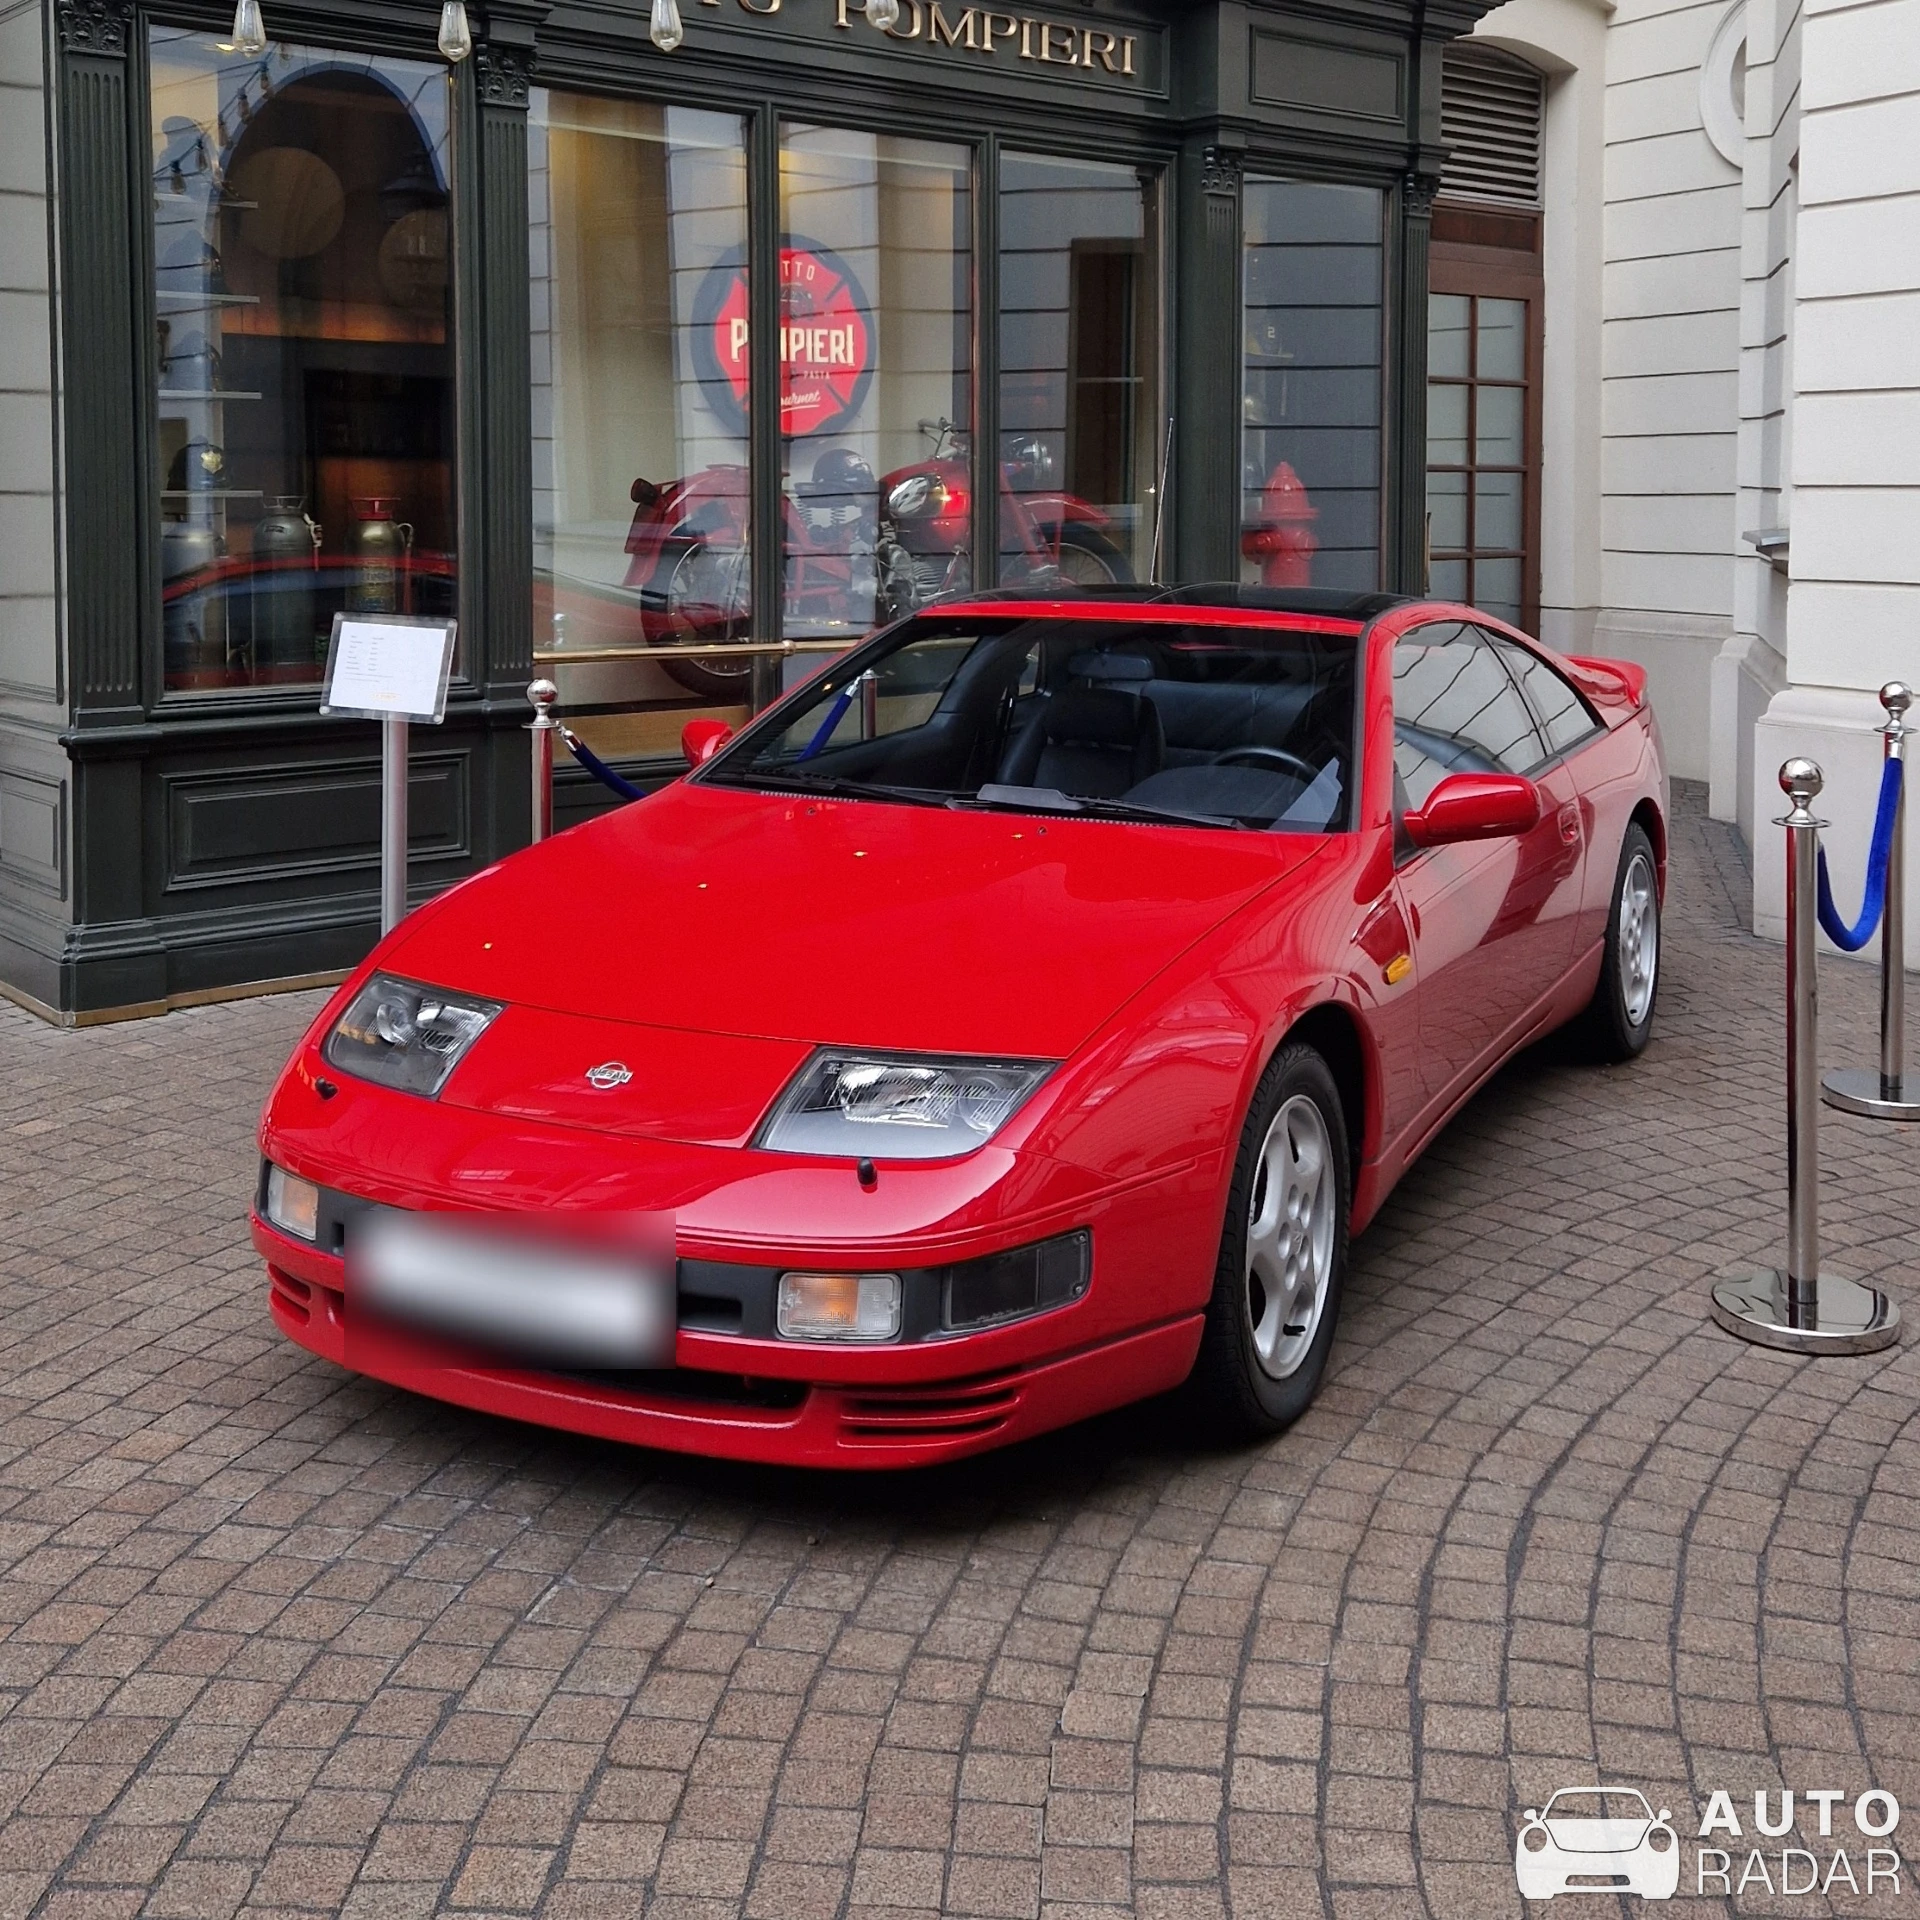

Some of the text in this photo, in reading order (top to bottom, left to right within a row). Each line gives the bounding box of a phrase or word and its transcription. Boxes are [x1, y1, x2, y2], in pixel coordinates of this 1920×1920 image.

[782, 260, 815, 281] TTO
[730, 317, 856, 366] PPIERI
[803, 370, 830, 380] PASTA
[780, 389, 821, 407] ourmet
[589, 1067, 630, 1081] NISSAN
